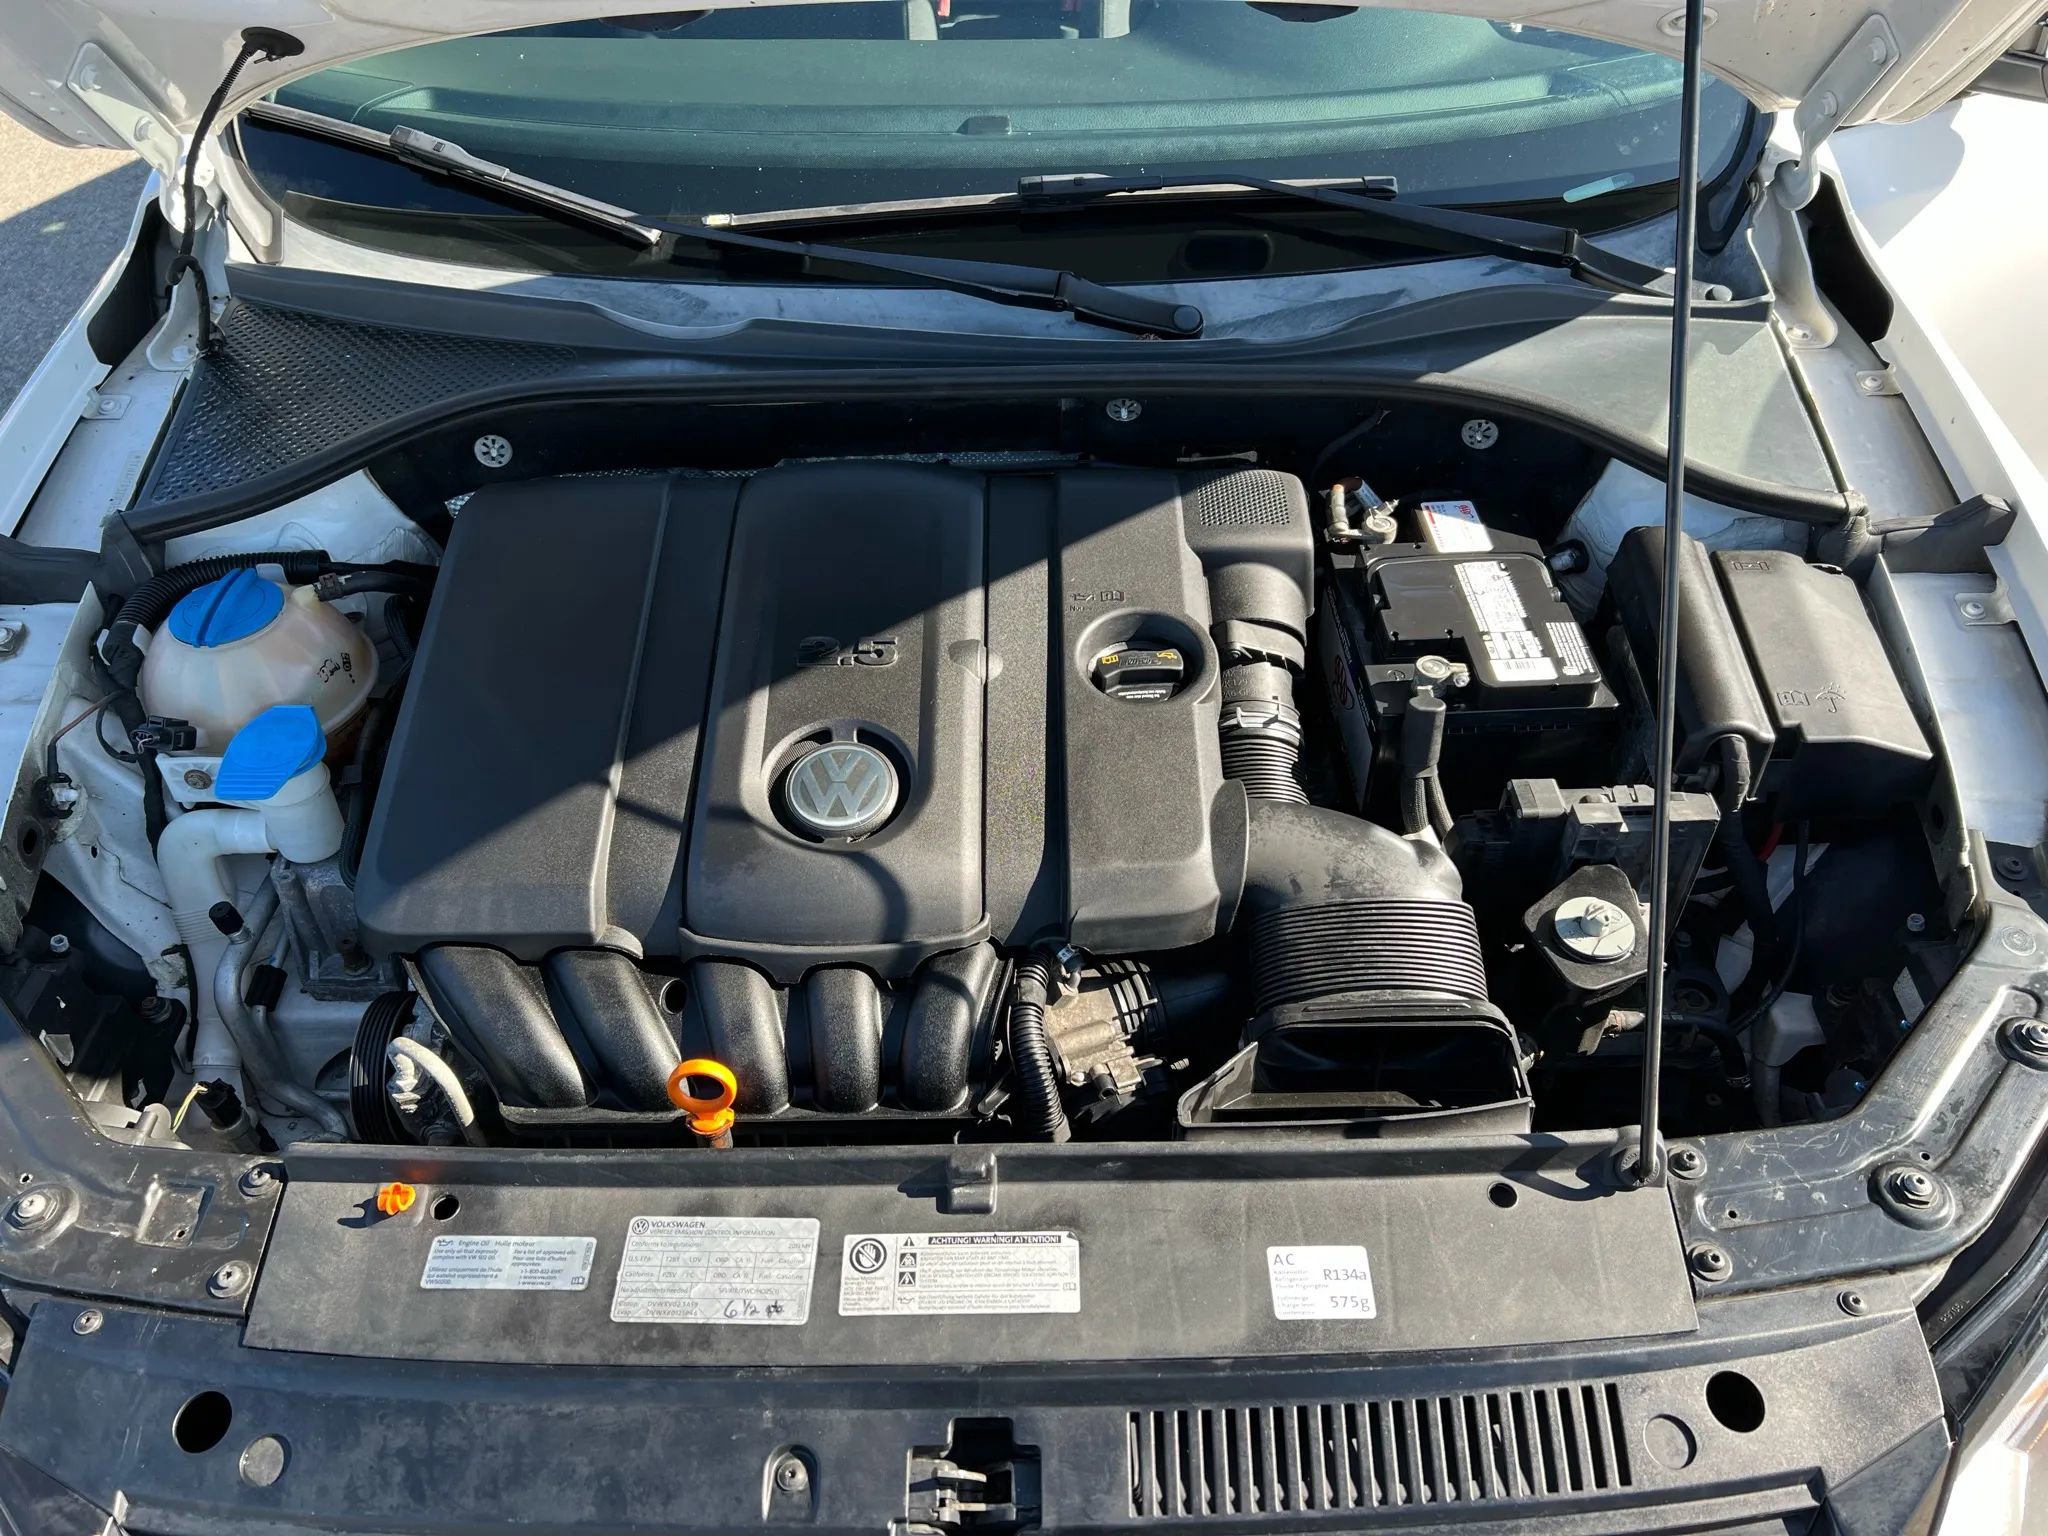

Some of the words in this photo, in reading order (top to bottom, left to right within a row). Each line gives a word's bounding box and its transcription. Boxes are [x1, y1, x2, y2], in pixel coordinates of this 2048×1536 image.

[796, 636, 898, 667] 2.5
[651, 1221, 705, 1229] VOLKSWAGEN
[931, 1236, 971, 1244] ACHTUNG!
[974, 1236, 1013, 1244] WARNING!
[1014, 1235, 1058, 1243] ATTENTION!
[1273, 1253, 1295, 1266] AC
[1323, 1268, 1367, 1281] R134a
[724, 1299, 738, 1319] 6
[1330, 1295, 1370, 1312] 575g
